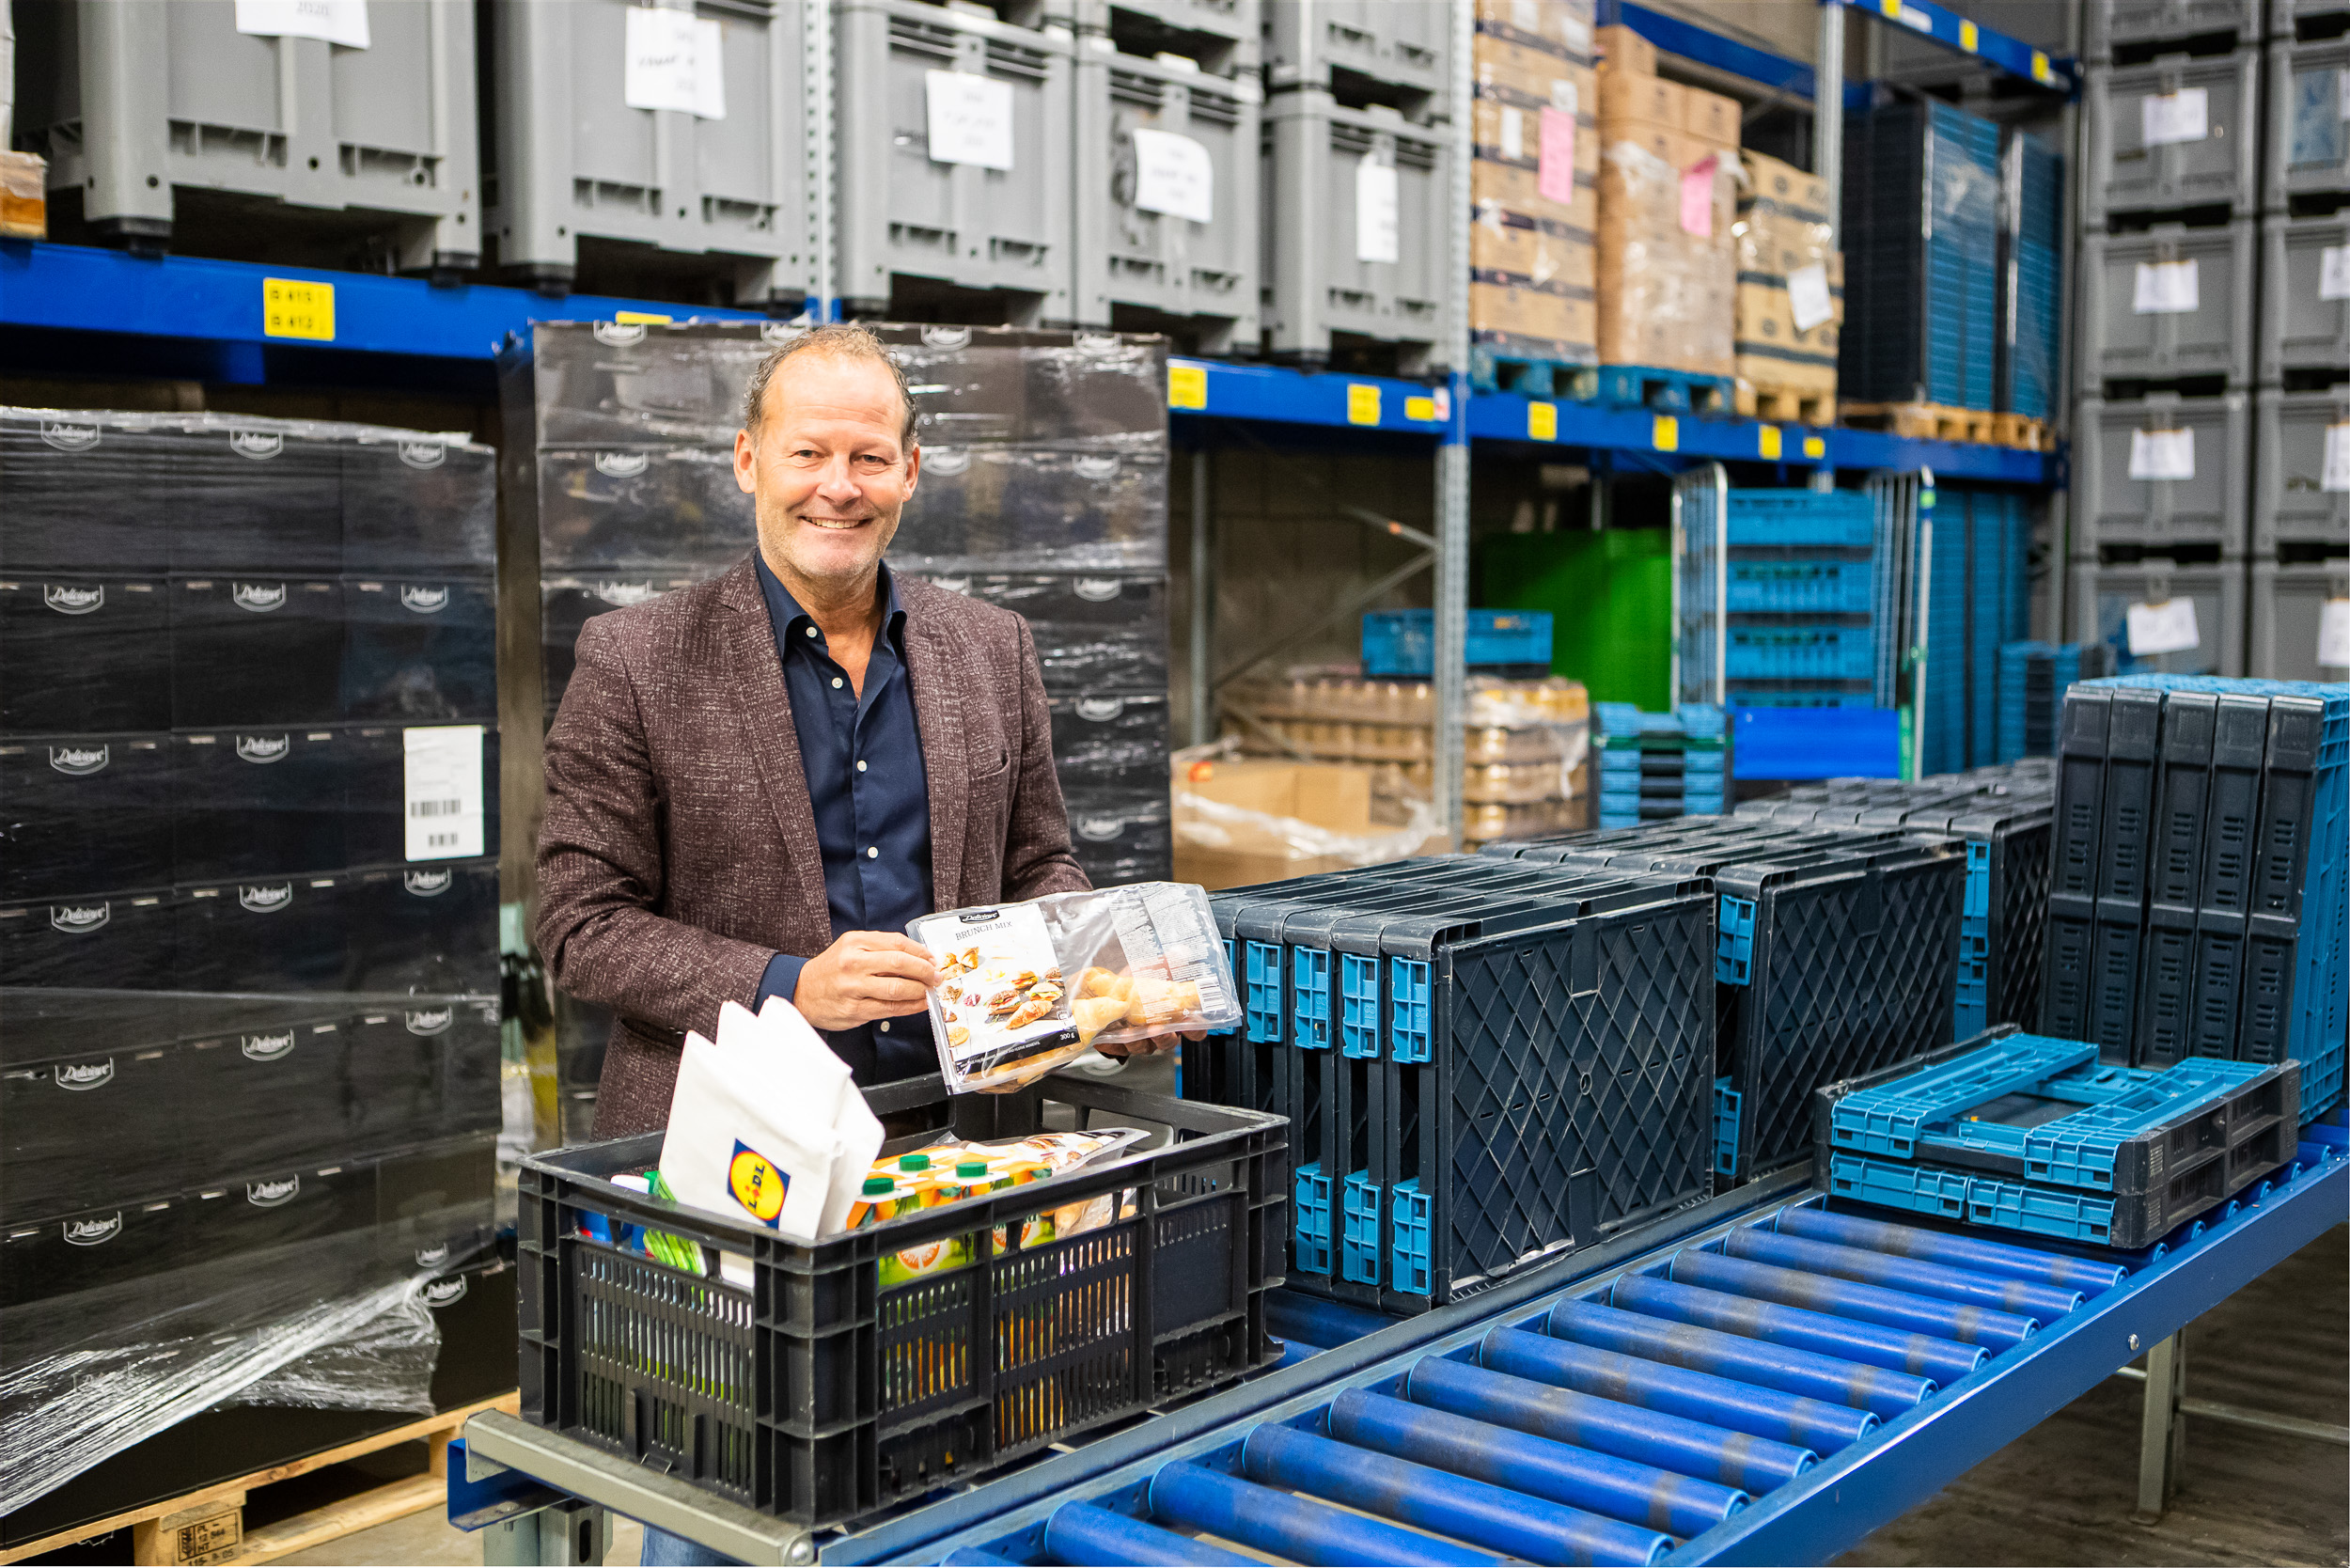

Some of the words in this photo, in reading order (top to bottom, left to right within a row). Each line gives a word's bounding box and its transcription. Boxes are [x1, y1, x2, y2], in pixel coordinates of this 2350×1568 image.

[955, 924, 994, 941] BRUNCH
[995, 921, 1013, 931] MIX
[1059, 1032, 1071, 1041] 300
